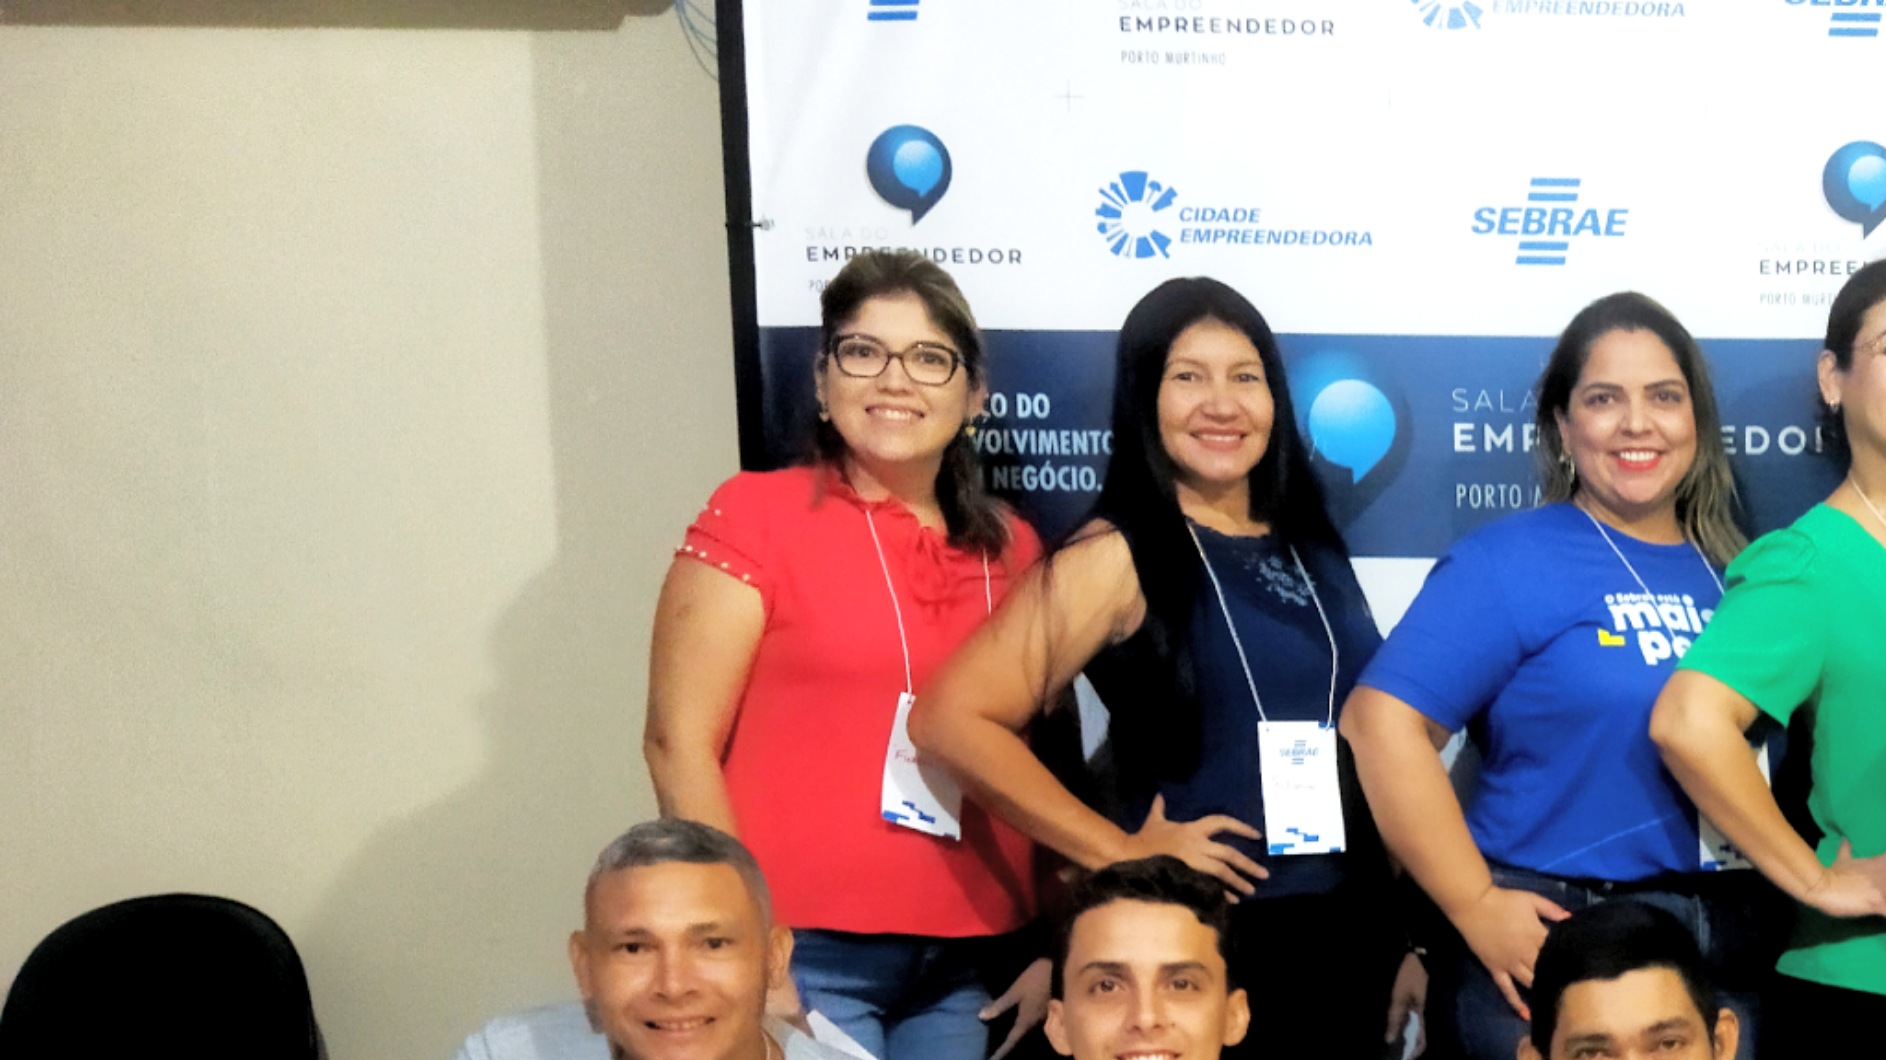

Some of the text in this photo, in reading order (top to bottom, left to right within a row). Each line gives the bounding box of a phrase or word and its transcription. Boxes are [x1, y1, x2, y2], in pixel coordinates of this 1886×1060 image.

[1492, 0, 1686, 17] EMPREENDEDORA
[1119, 15, 1335, 35] EMPREENDEDOR
[1121, 50, 1159, 64] PORTO
[1179, 207, 1261, 223] CIDADE
[1471, 207, 1629, 236] SEBRAE
[1179, 229, 1373, 246] EMPREENDEDORA
[1016, 392, 1050, 419] DO
[1456, 484, 1522, 508] PORTO
